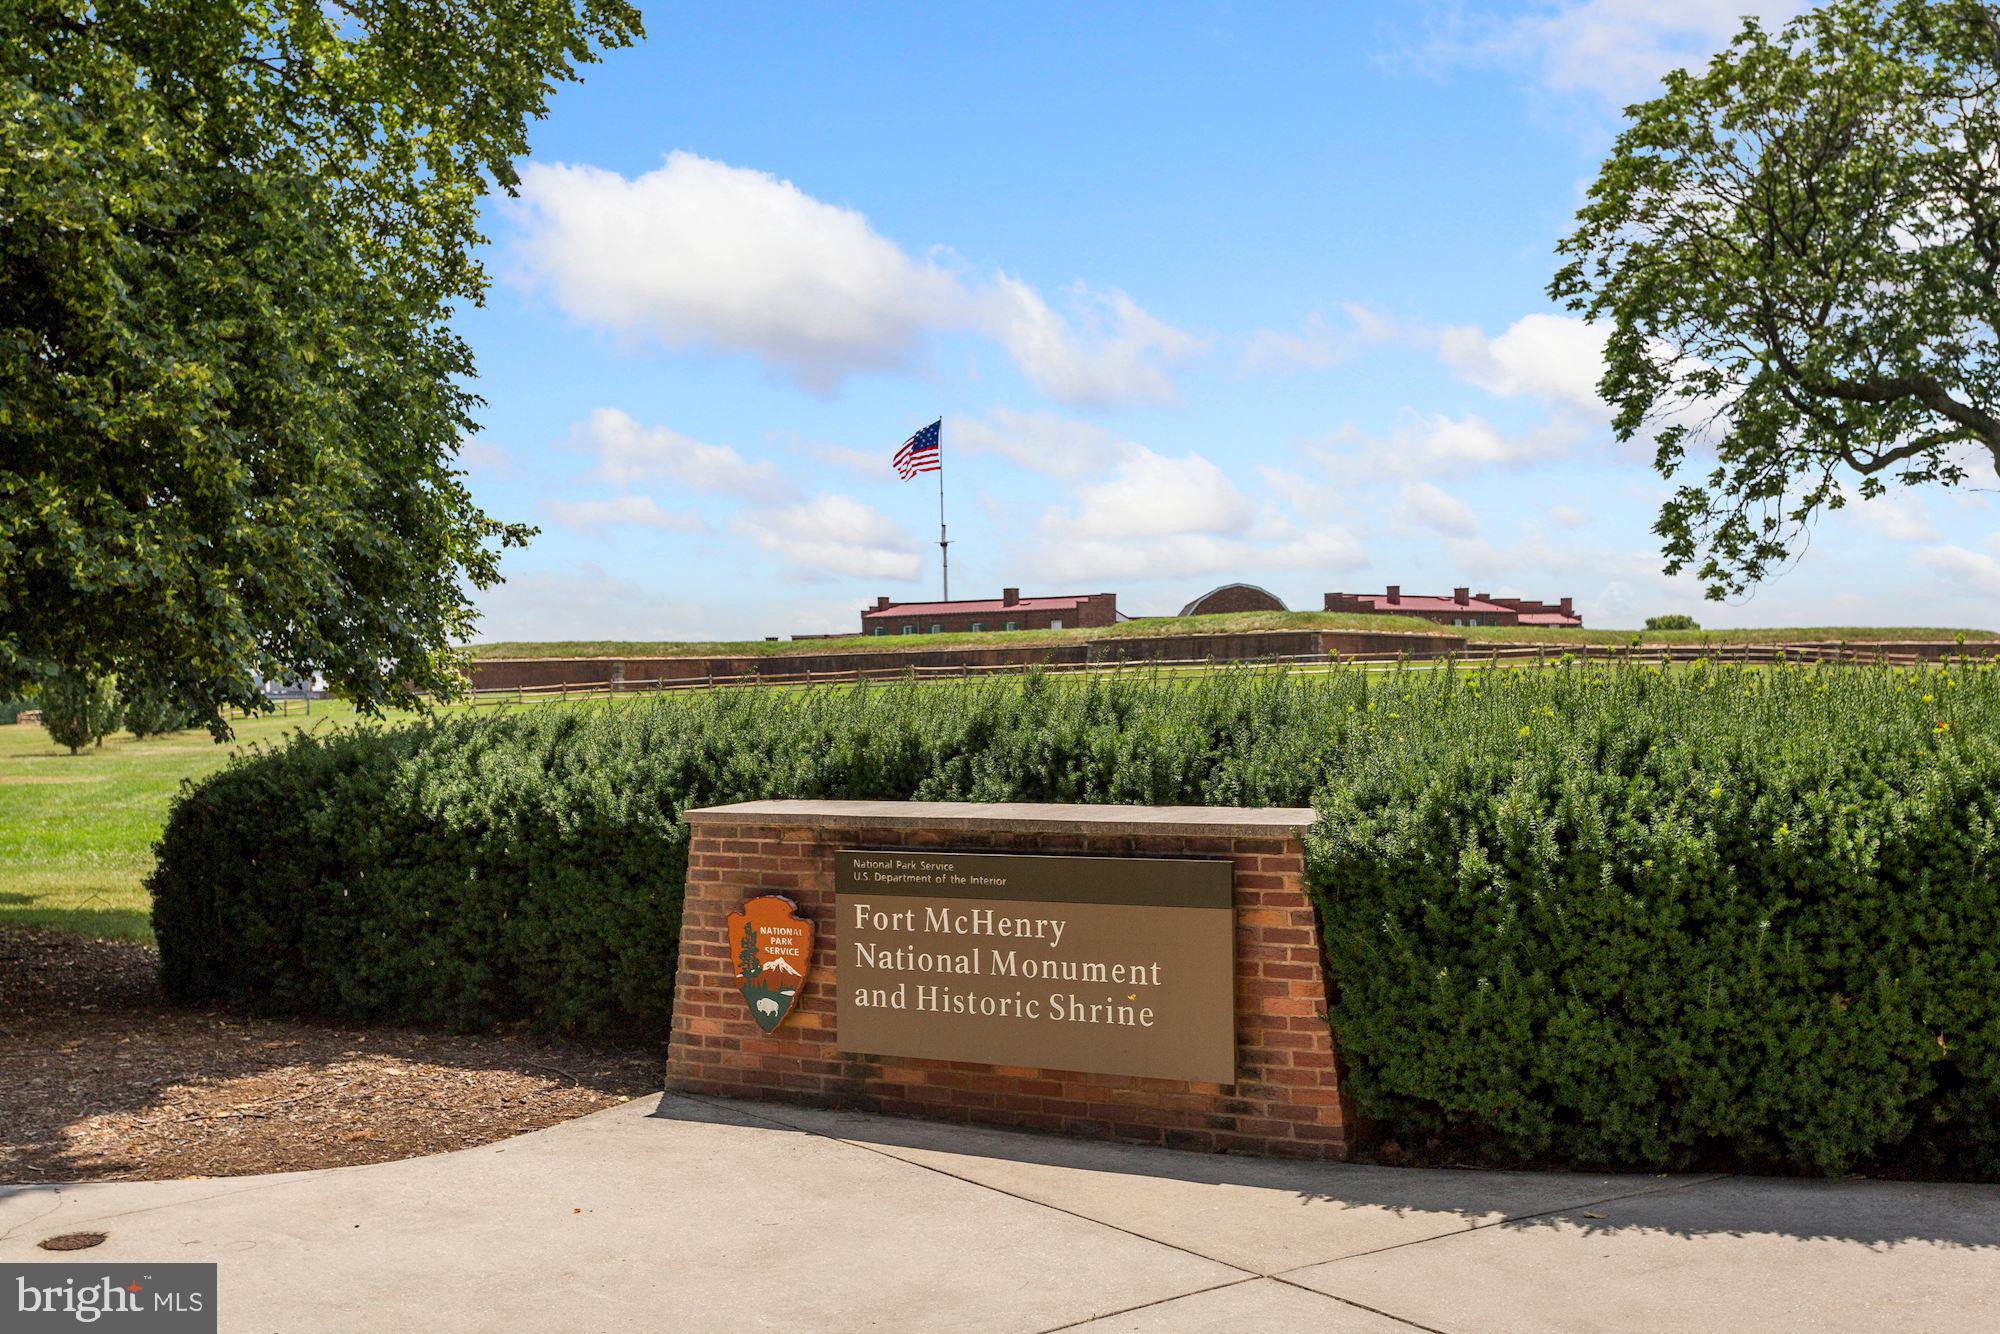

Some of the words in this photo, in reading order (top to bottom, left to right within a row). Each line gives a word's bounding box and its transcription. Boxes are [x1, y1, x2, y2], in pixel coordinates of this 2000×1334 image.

[853, 859, 891, 870] National
[896, 860, 916, 870] Park
[920, 861, 954, 872] Service
[853, 872, 869, 881] U.S.
[874, 873, 932, 885] Department
[935, 874, 947, 884] of
[950, 874, 967, 884] the
[970, 875, 1007, 886] Interior
[759, 926, 803, 936] NATIONAL
[854, 904, 915, 932] Fort
[924, 907, 1066, 948] McHenry
[770, 937, 793, 946] PARK
[764, 946, 800, 957] SERVICE
[854, 942, 981, 975] National
[991, 950, 1162, 986] Monument
[854, 983, 906, 1010] and
[916, 986, 1040, 1019] Historic
[1049, 993, 1154, 1028] Shrine
